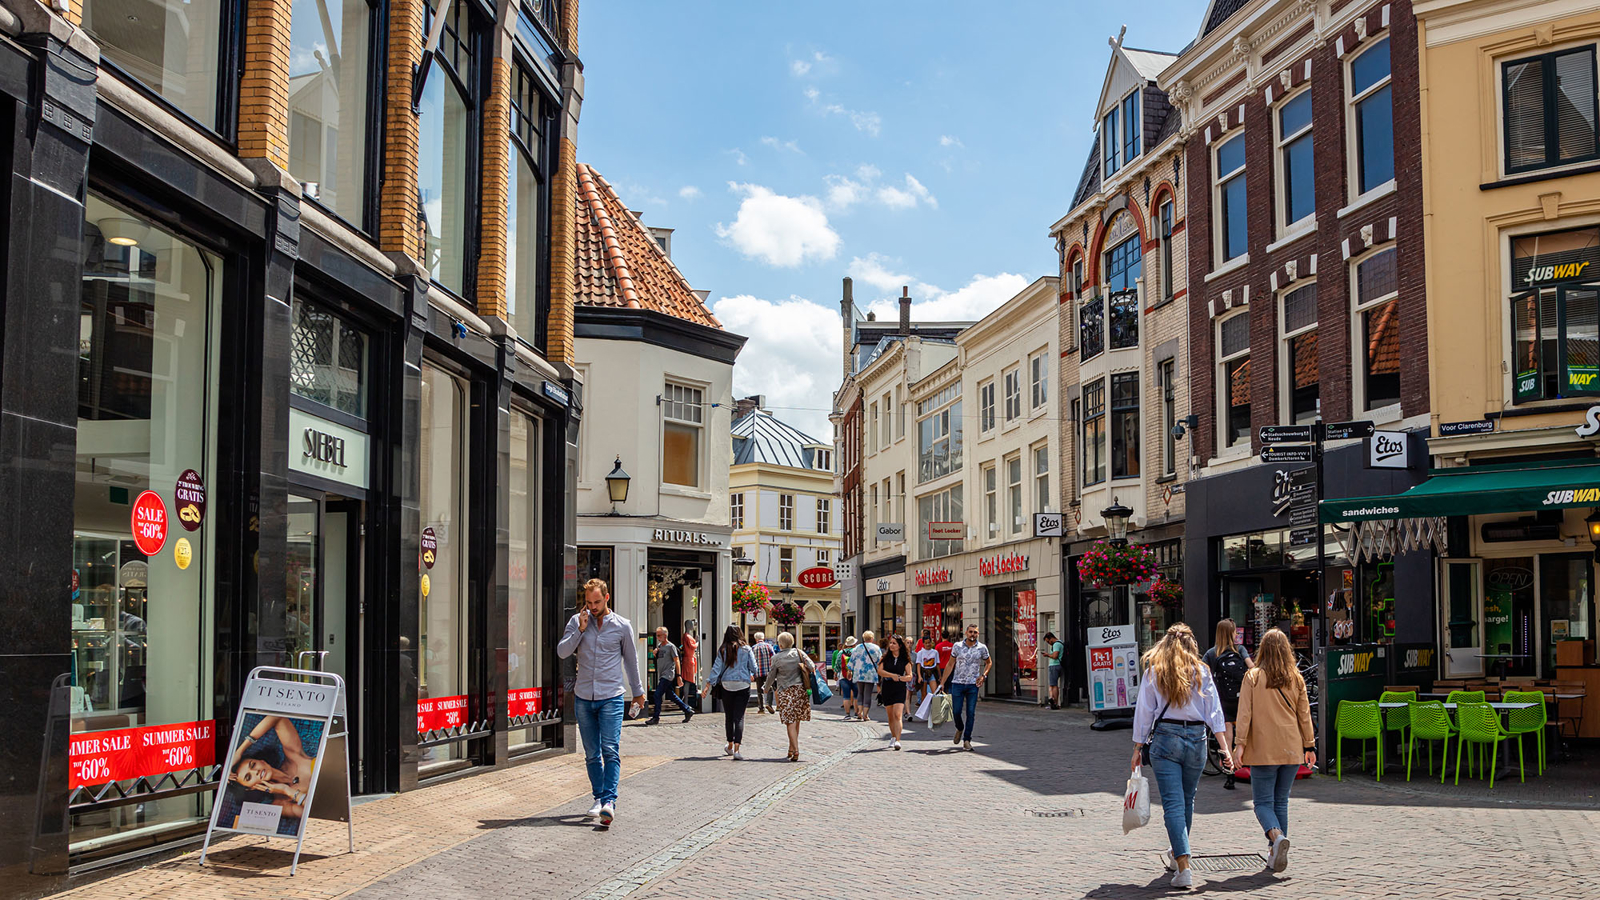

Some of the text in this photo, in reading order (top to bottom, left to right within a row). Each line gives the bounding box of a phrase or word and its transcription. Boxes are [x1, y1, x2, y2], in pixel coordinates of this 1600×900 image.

[1523, 260, 1590, 283] SUBWAY
[1519, 378, 1535, 393] SUB
[1569, 373, 1598, 385] WAY
[1457, 421, 1493, 430] Clarenburg
[303, 427, 348, 468] SIEBEL
[1375, 435, 1403, 461] Etos
[177, 488, 204, 503] GRATIS
[1542, 488, 1600, 505] SUBWAY
[137, 506, 164, 523] SALE
[1342, 505, 1400, 517] sandwiches
[140, 522, 163, 540] -60%
[879, 526, 902, 535] Gabor
[1040, 516, 1059, 532] Etos
[979, 551, 1026, 577] Foot Locker
[803, 572, 833, 584] SCORE
[915, 565, 950, 586] Foot Locker
[1488, 571, 1527, 586] OPEN
[1019, 605, 1035, 619] SALE
[1484, 614, 1509, 625] arge!
[923, 616, 935, 628] SALE
[1101, 627, 1121, 643] Etos
[1093, 652, 1110, 662] 1+1
[1337, 651, 1374, 675] SUBWAY
[1404, 648, 1434, 668] SUBWAY
[257, 685, 326, 703] TI SENTO
[102, 735, 131, 752] SALE
[142, 728, 185, 747] SUMMER
[185, 726, 210, 741] SALE
[165, 745, 193, 767] -60%
[76, 757, 110, 781] -60%
